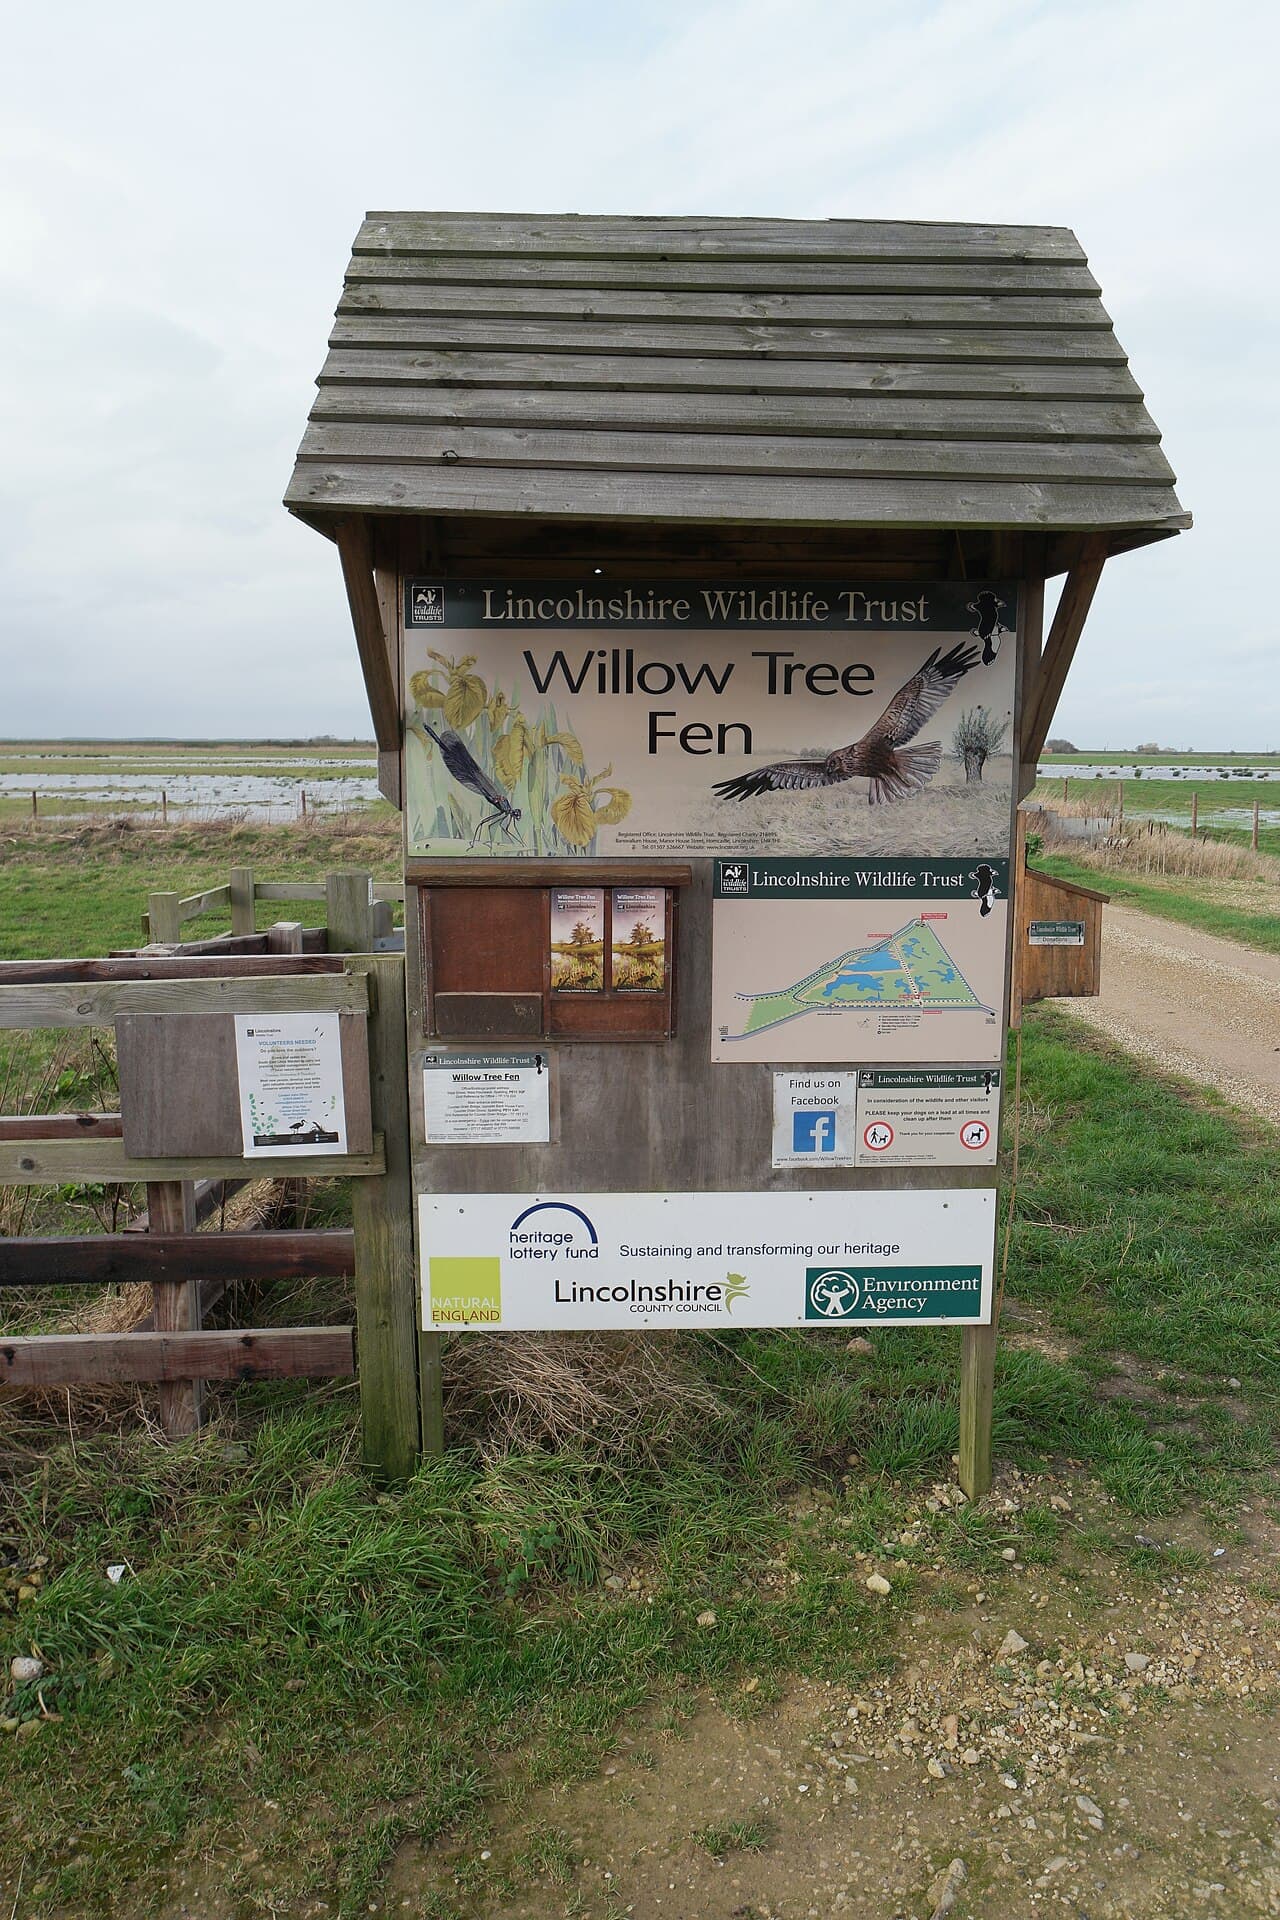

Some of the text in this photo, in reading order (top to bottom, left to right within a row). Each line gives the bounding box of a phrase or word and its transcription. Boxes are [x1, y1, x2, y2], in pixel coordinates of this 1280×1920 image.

[482, 589, 930, 622] Lincolnshire Wildlife Trust
[523, 649, 875, 696] Willow Tree
[648, 711, 752, 755] Fen
[752, 871, 964, 887] Lincolnshire Wildlife Trust
[439, 1057, 480, 1065] Lincolnshire
[504, 1073, 520, 1081] Fen
[789, 1080, 811, 1088] Find
[828, 1080, 841, 1088] on
[878, 1075, 924, 1083] Lincolnshire
[926, 1075, 955, 1083] Wildlife
[791, 1096, 839, 1105] Facebook
[510, 1231, 574, 1246] heritage
[510, 1247, 599, 1261] lottery fund
[619, 1243, 900, 1259] Sustaining and transforming our heritage
[555, 1279, 722, 1303] Lincolnshire
[862, 1277, 979, 1292] Environment
[432, 1297, 499, 1309] NATURAL
[629, 1303, 722, 1313] COUNTY COUNCIL
[861, 1296, 927, 1313] Agency
[432, 1310, 500, 1321] ENGLAND
